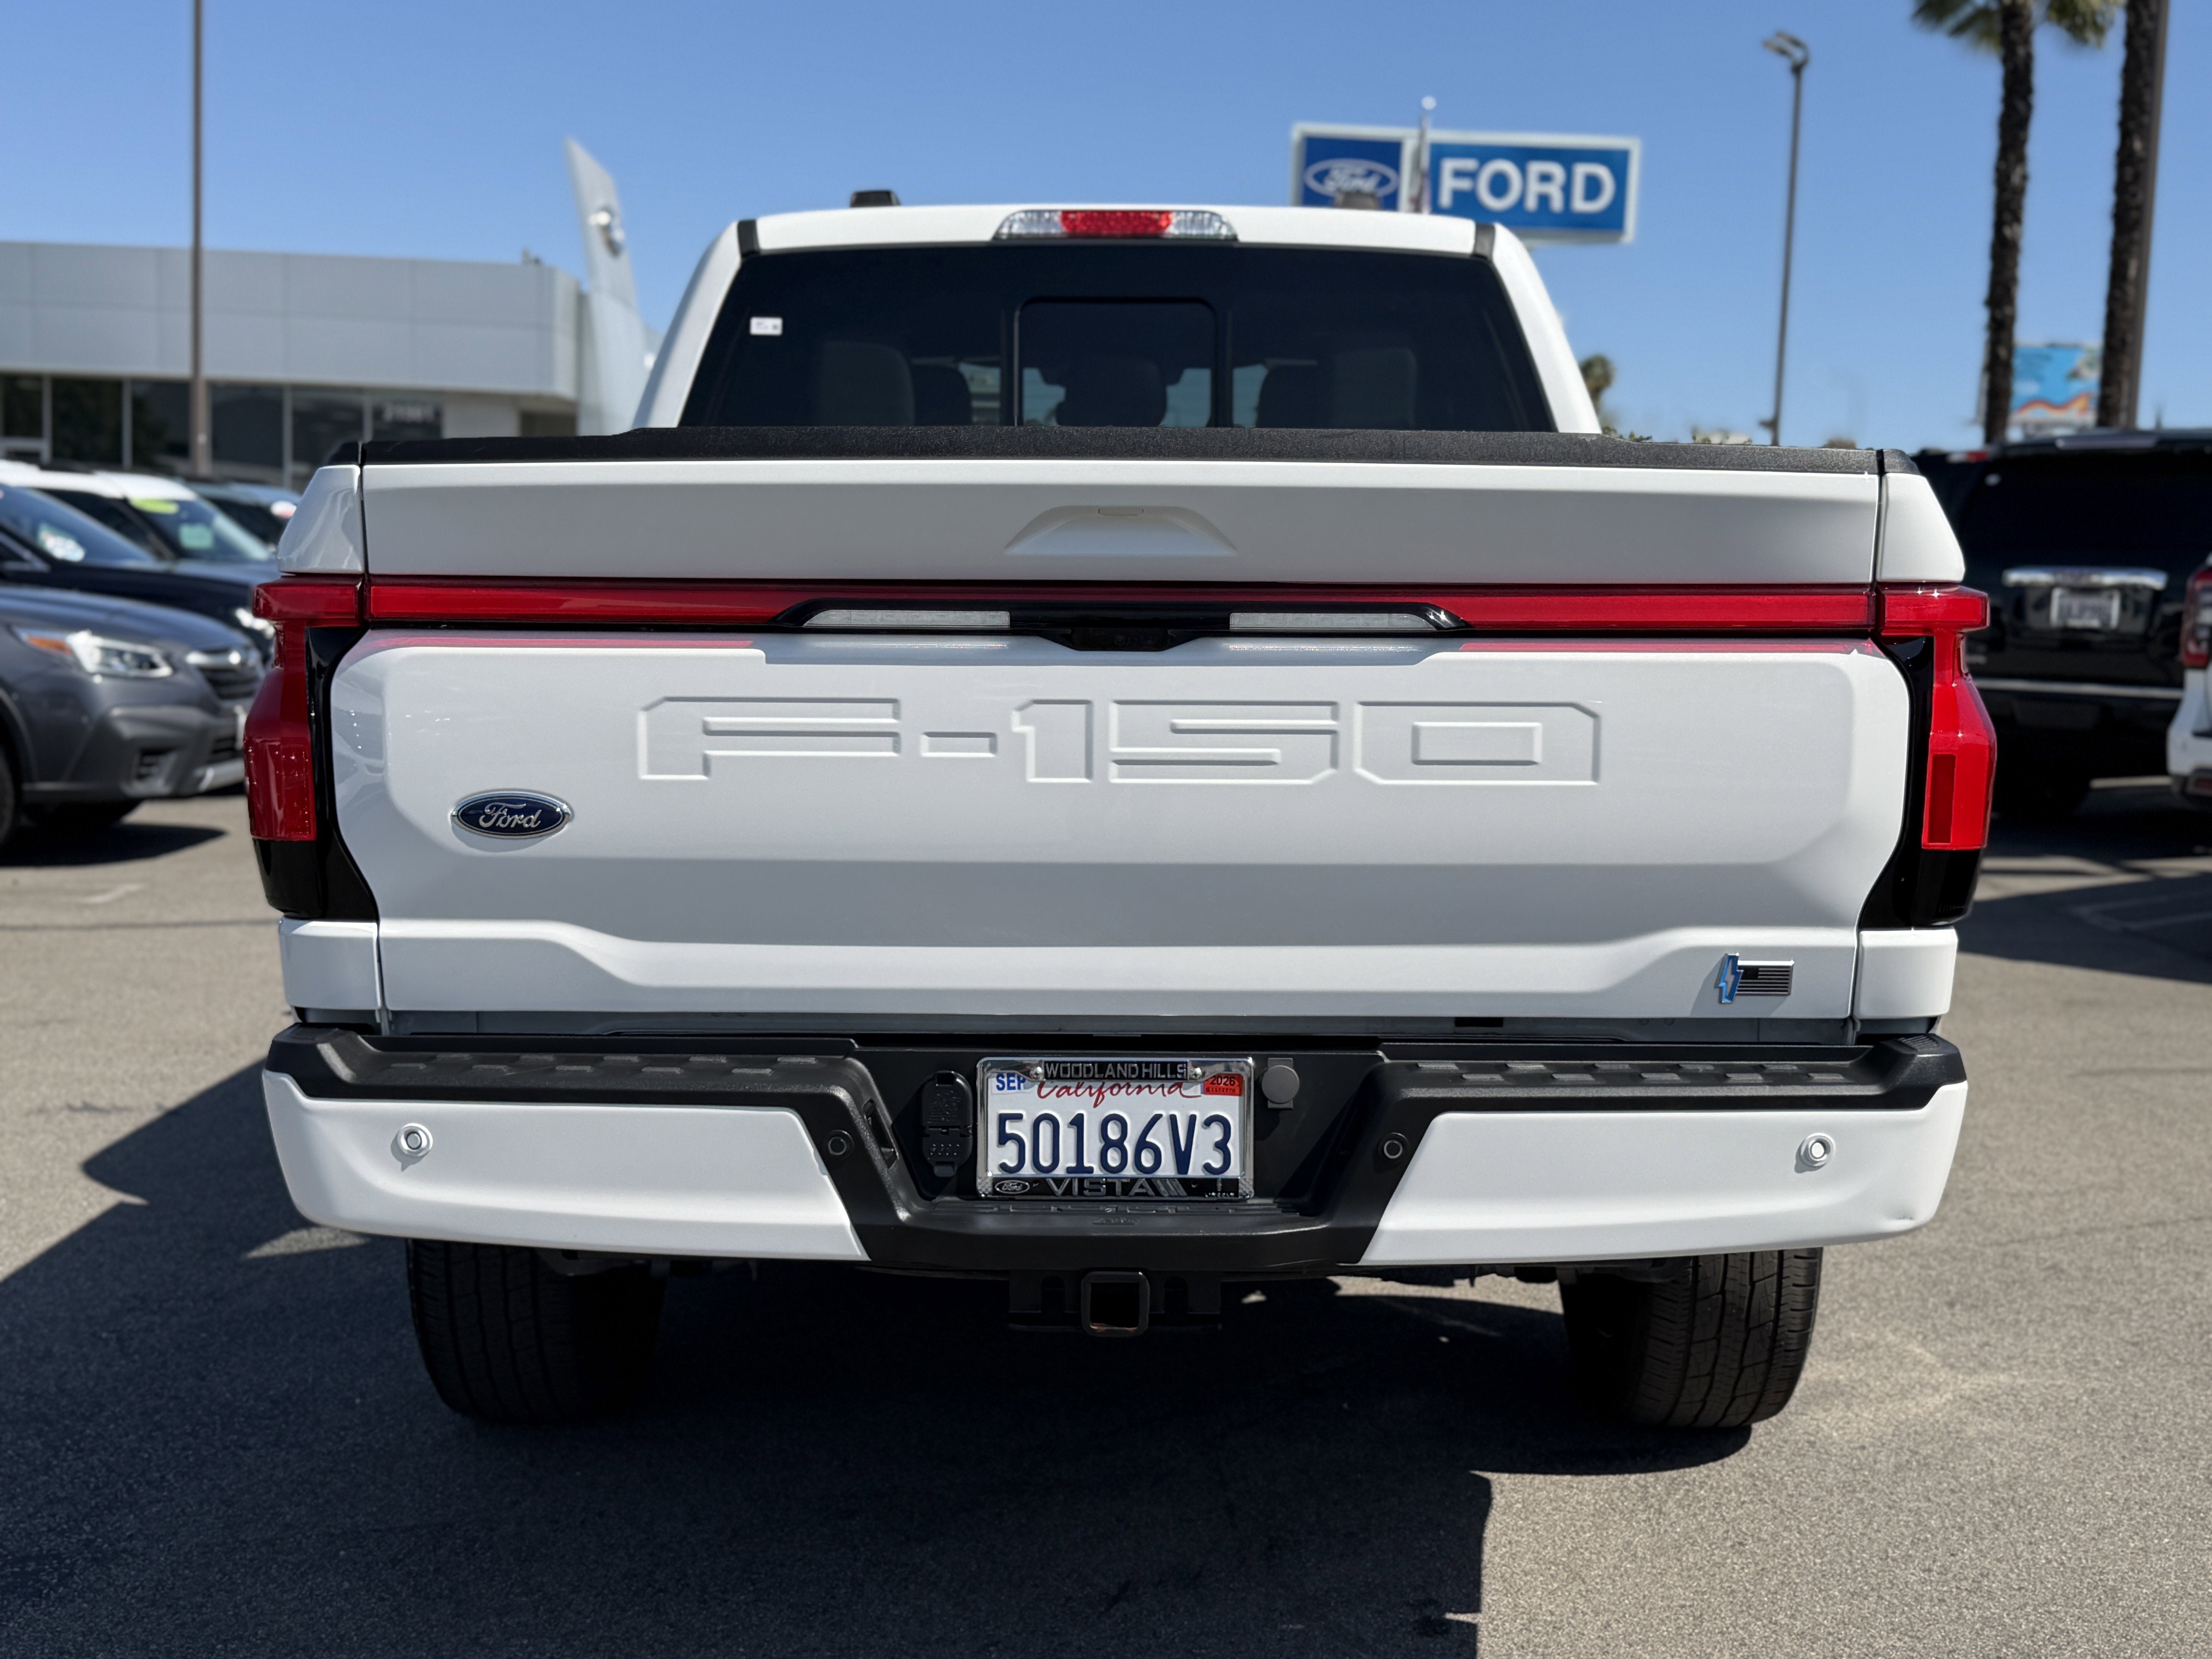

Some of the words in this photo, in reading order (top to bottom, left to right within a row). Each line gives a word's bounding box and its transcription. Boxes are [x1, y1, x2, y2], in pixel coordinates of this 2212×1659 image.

[1437, 157, 1616, 214] FORD
[637, 695, 1602, 785] F-150
[479, 802, 542, 828] Ford
[996, 1073, 1026, 1091] SEP
[1046, 1063, 1139, 1079] WOODLAND
[1142, 1063, 1187, 1079] HILLS
[1210, 1075, 1236, 1087] 2026
[1037, 1081, 1202, 1108] California
[998, 1113, 1231, 1176] 50186V3
[1001, 1181, 1023, 1191] Ford
[1046, 1178, 1153, 1197] VISTA
